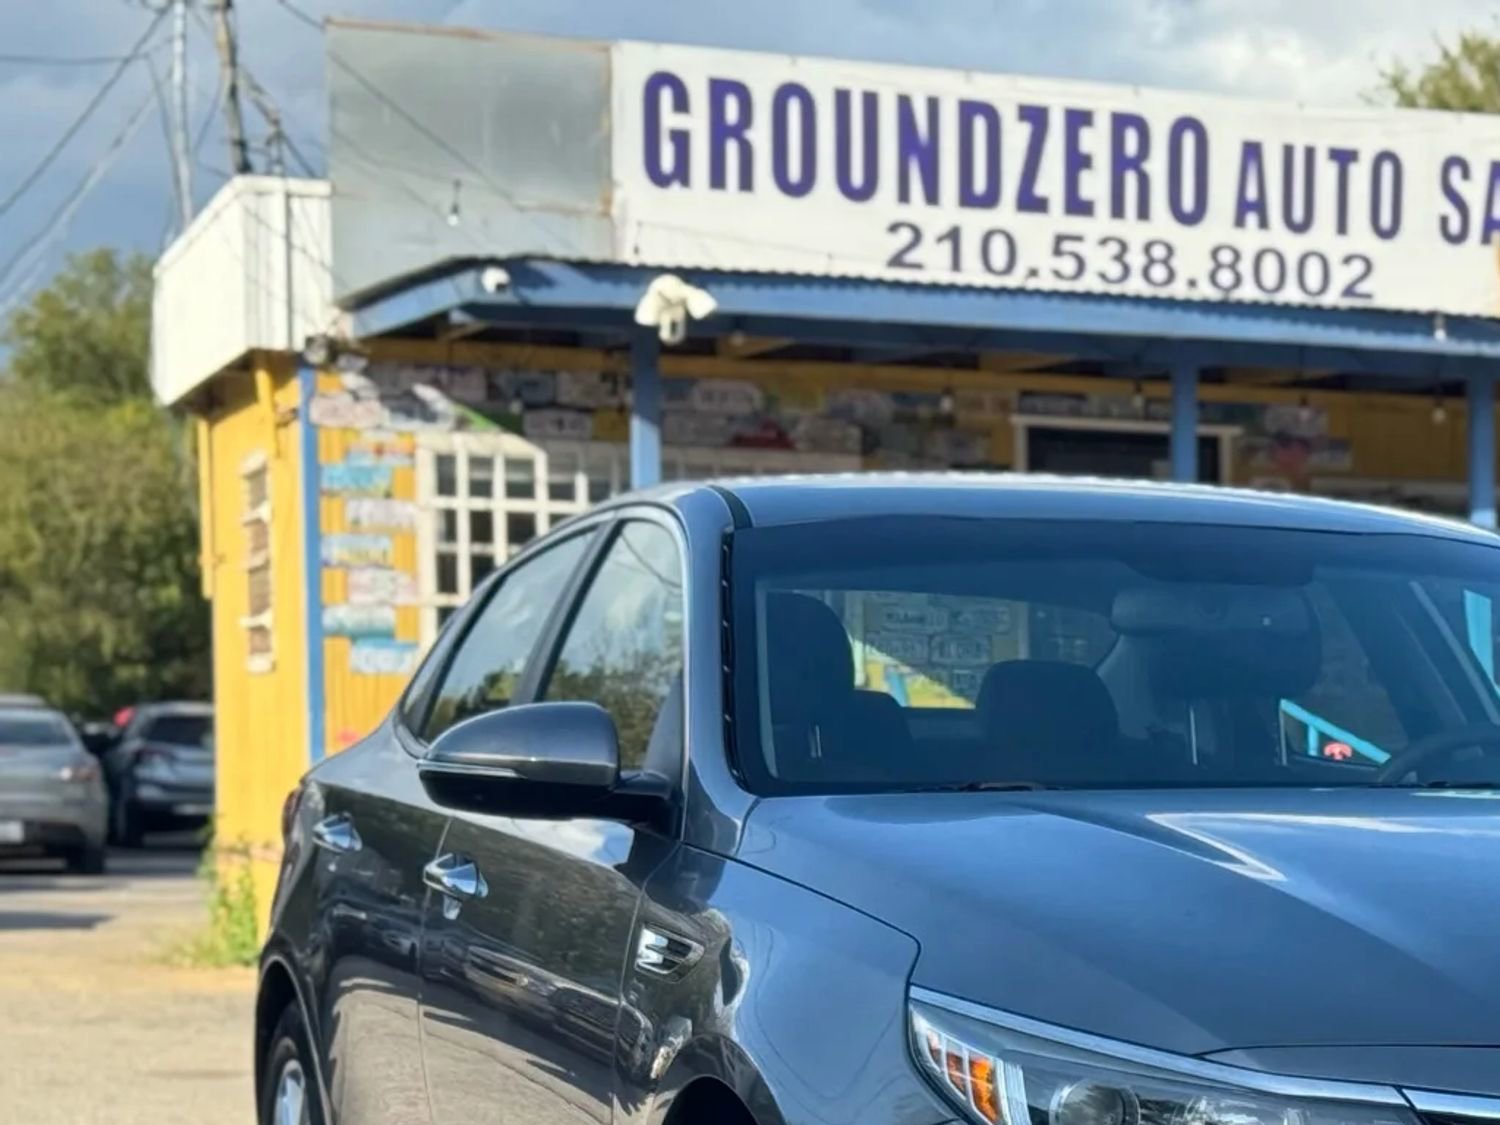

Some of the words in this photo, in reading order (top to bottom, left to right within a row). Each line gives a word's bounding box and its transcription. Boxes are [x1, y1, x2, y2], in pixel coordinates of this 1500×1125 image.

[642, 70, 1210, 227] GROUNDZERO
[1233, 140, 1404, 240] AUTO
[886, 221, 1374, 299] 210.538.8002
